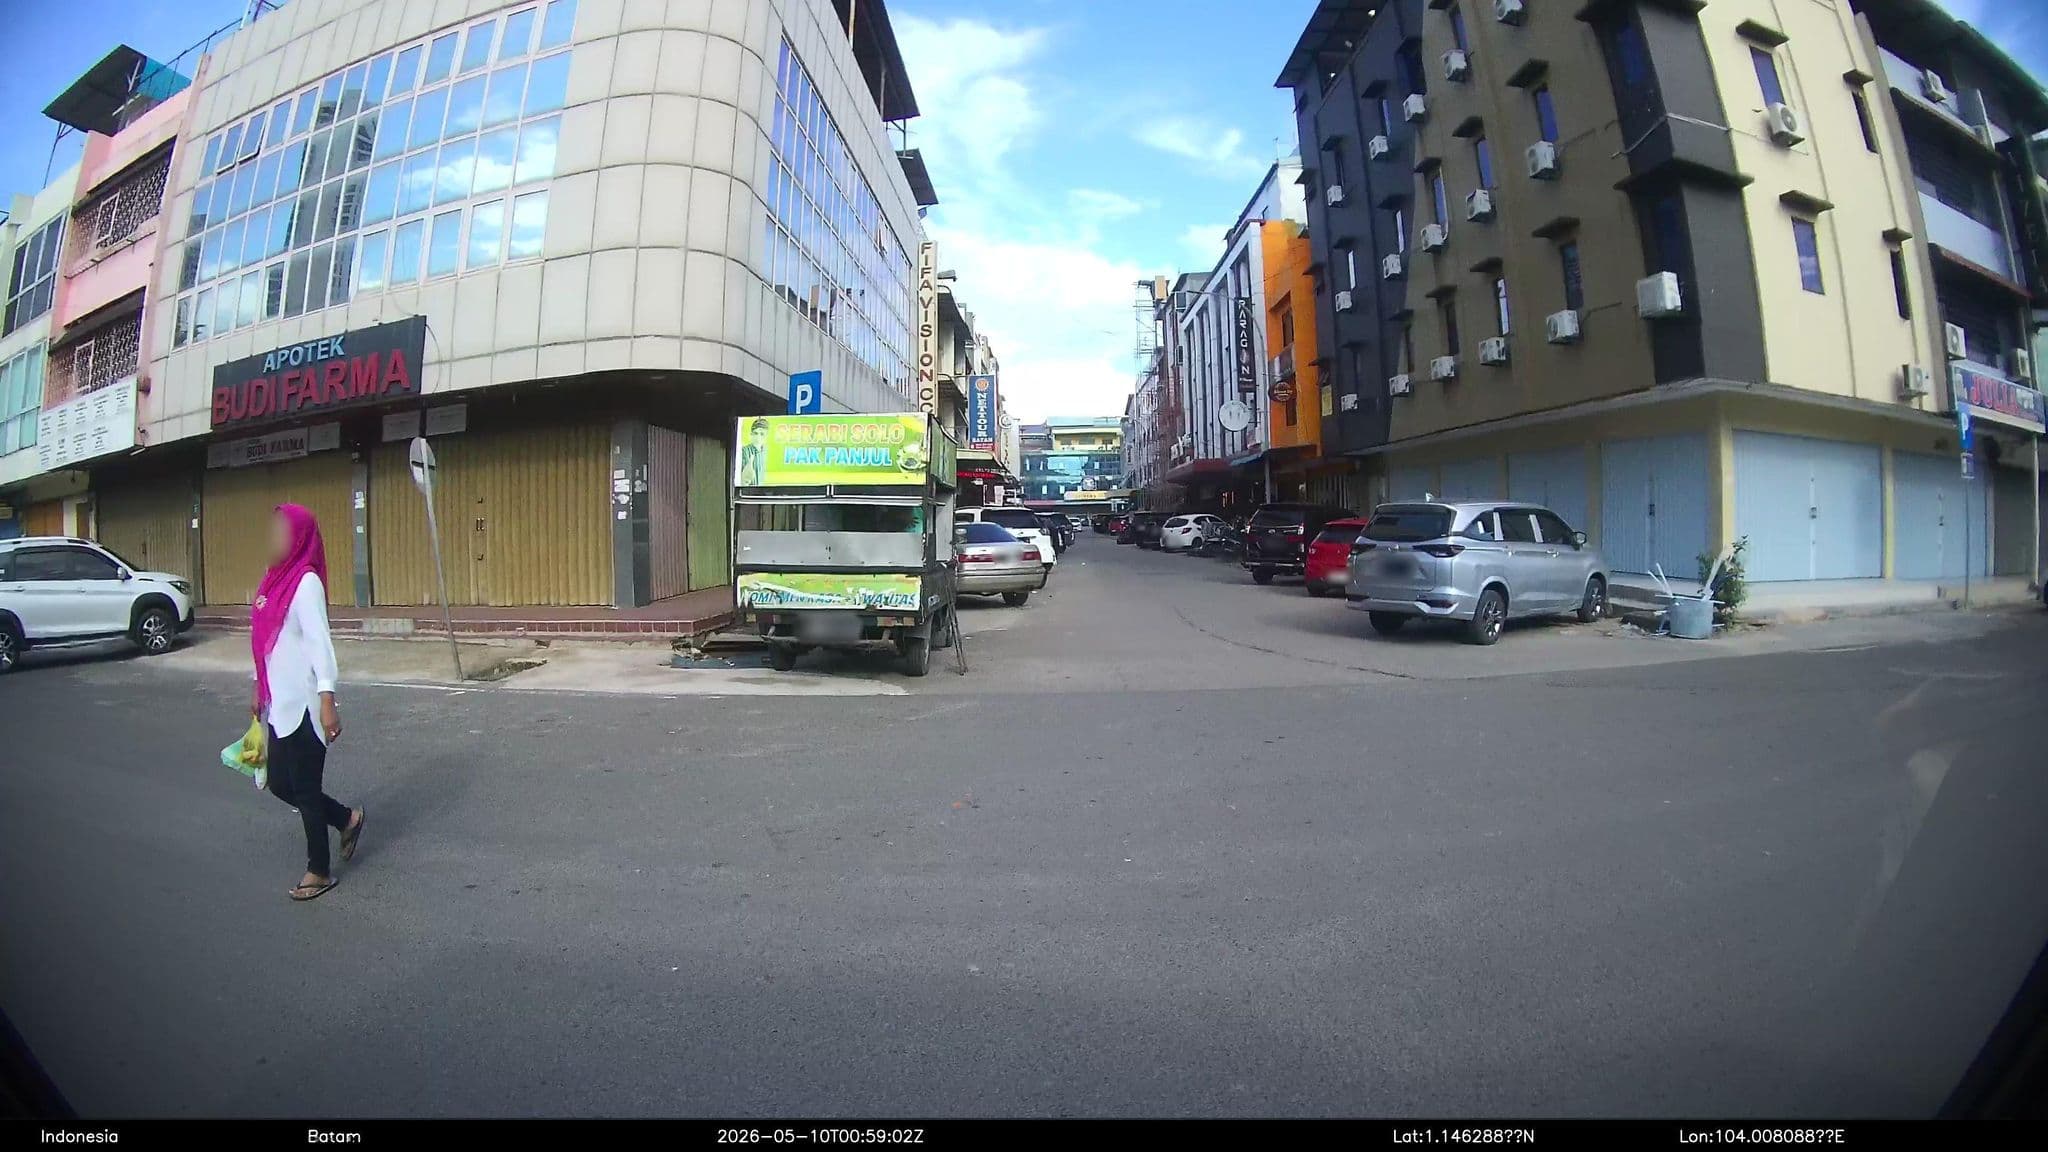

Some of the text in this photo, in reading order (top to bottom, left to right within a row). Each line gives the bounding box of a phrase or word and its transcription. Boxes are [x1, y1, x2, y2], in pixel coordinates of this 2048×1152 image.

[920, 296, 934, 382] VISION
[263, 335, 345, 374] APOTEK
[796, 383, 813, 414] P
[775, 423, 906, 444] SERABI SOLO
[1961, 412, 1969, 440] P
[784, 447, 893, 466] PAK PANJUL
